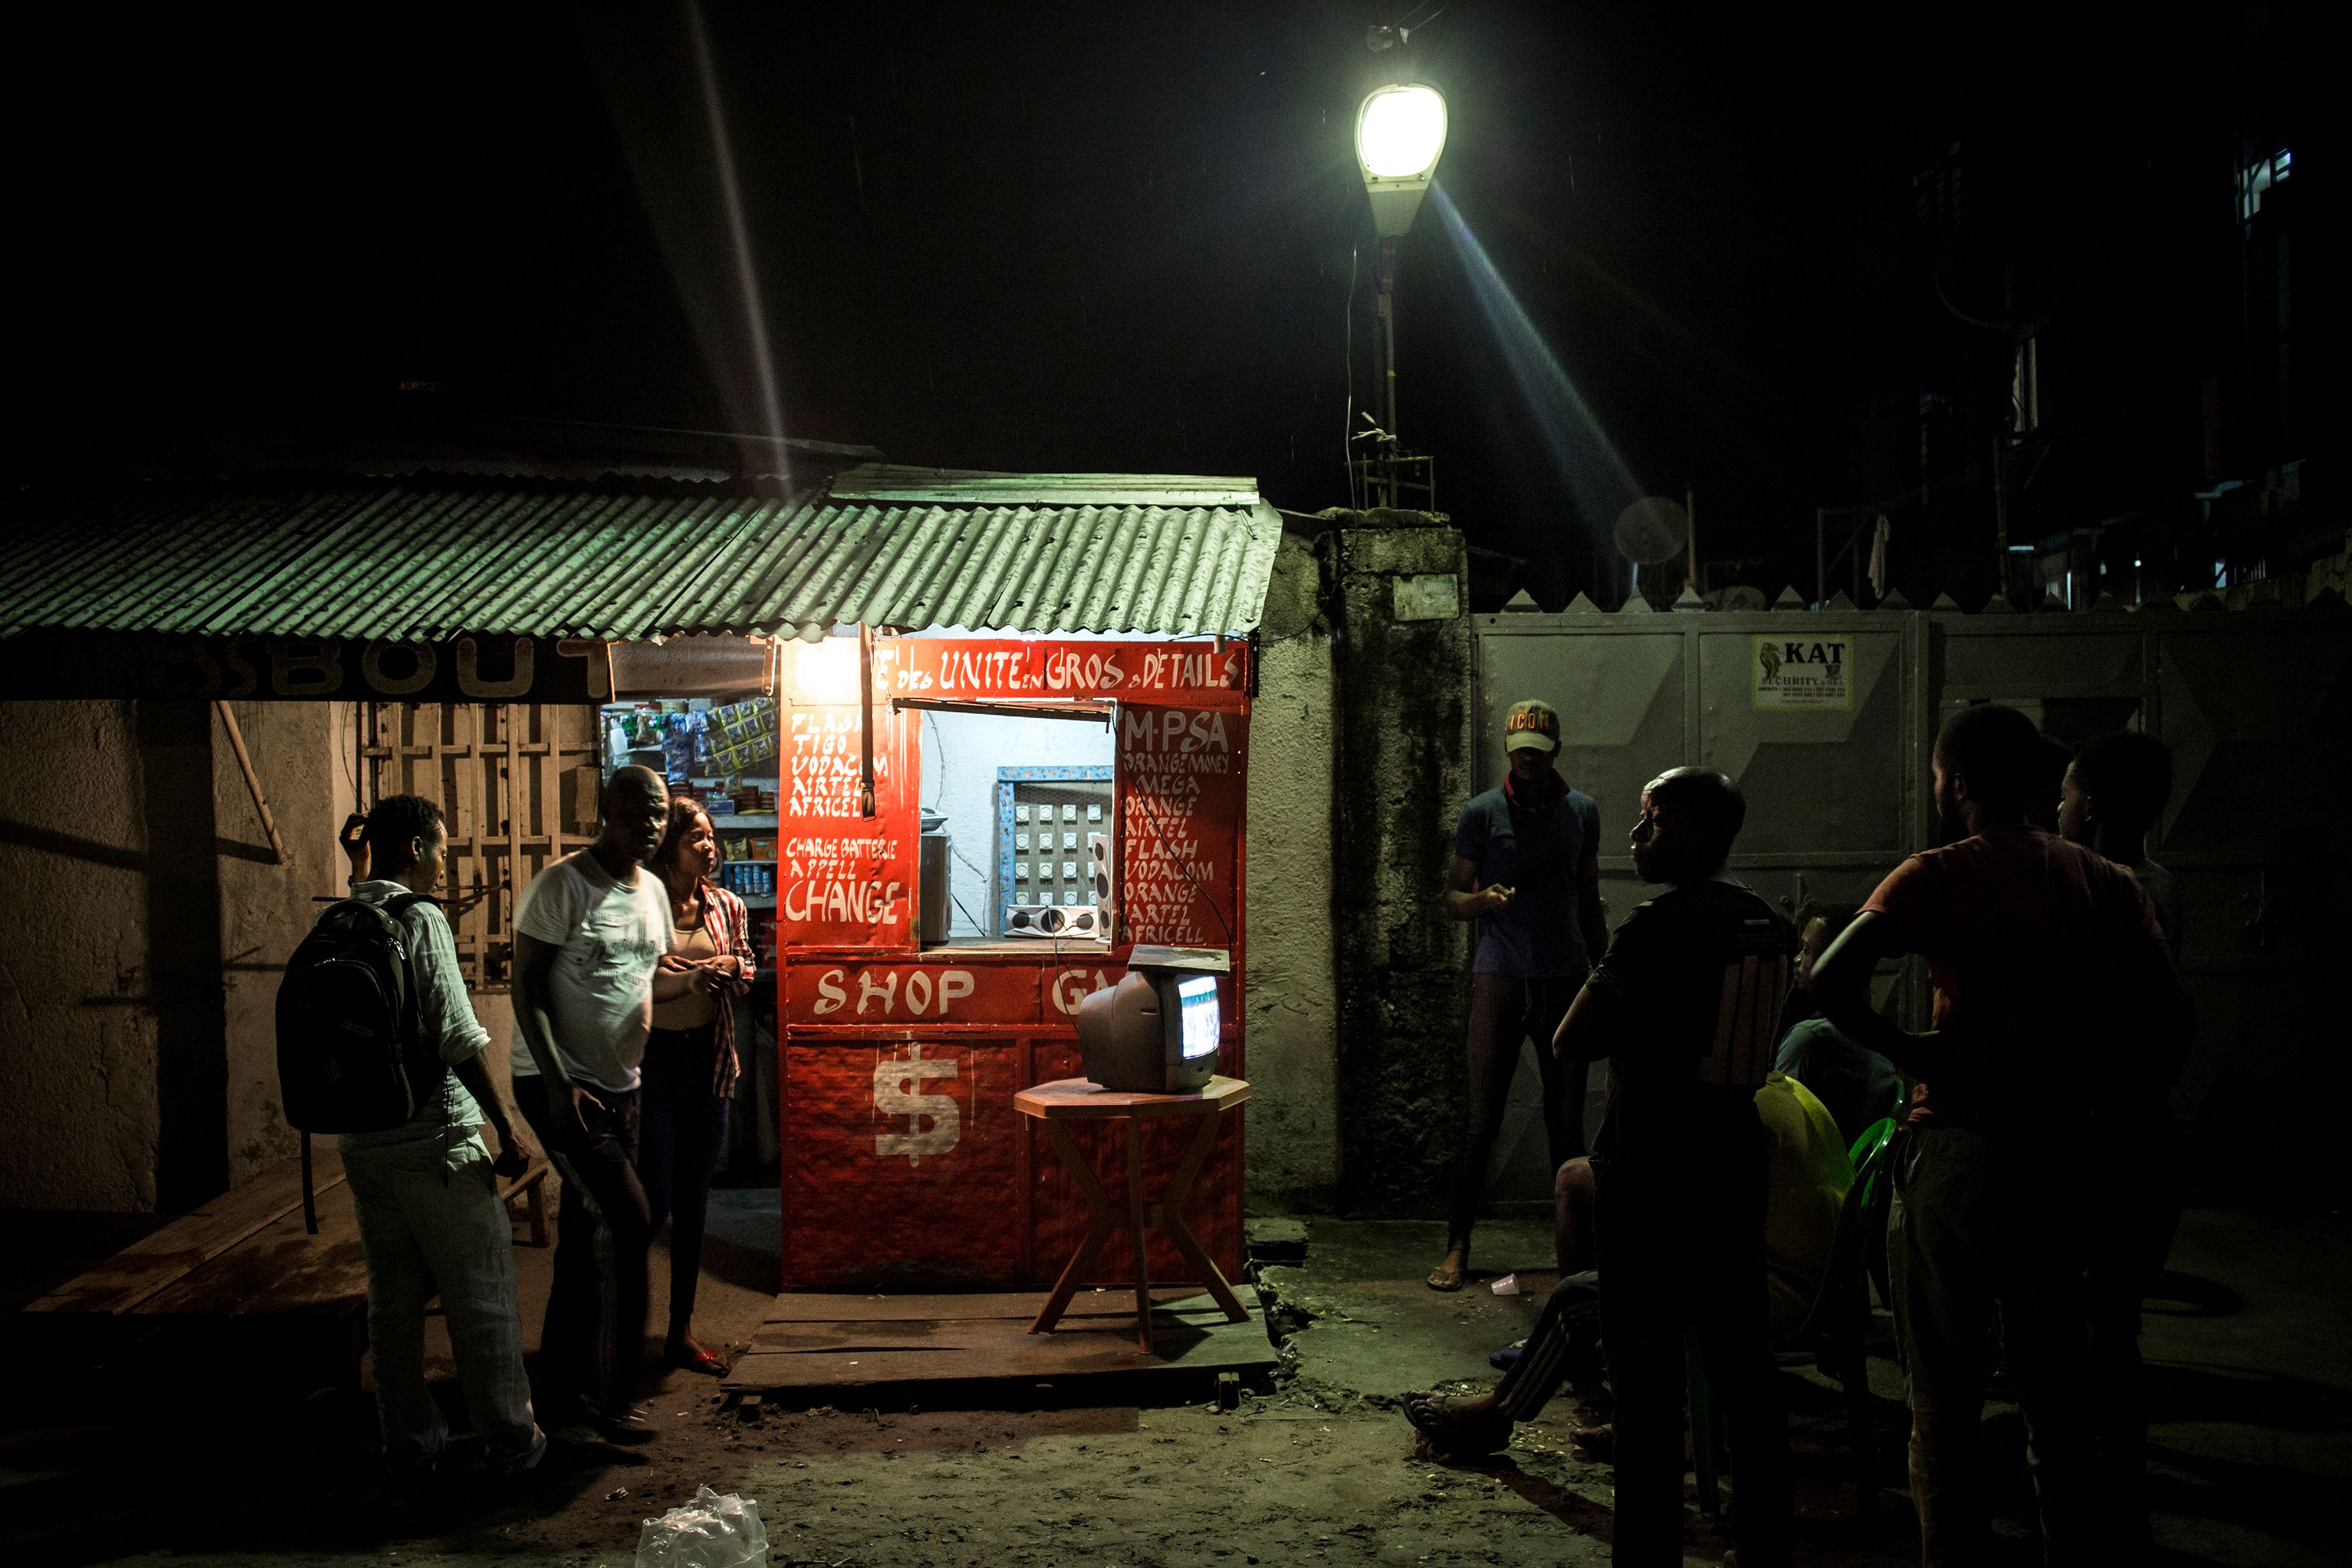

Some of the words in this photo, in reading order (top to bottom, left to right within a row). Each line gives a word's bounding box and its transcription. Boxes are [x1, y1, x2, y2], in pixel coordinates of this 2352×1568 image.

[1785, 643, 1845, 663] KAT
[1047, 649, 1125, 690] GROS
[1510, 711, 1551, 731] ICON
[792, 734, 847, 755] TIGO
[792, 776, 862, 796] AIRTEL
[1135, 774, 1201, 795] MEGA
[1125, 796, 1197, 817] ORANGE
[1125, 817, 1188, 838] AIRTEL
[786, 837, 838, 858] CHARGE
[840, 838, 898, 860] BATTERIE
[1125, 840, 1198, 860] FLASH
[1124, 861, 1214, 881] VODACOM
[785, 880, 900, 924] CHANGE
[1124, 882, 1198, 904] ORANGE
[1122, 925, 1204, 943] AFRICELL
[813, 969, 975, 1016] SHOP
